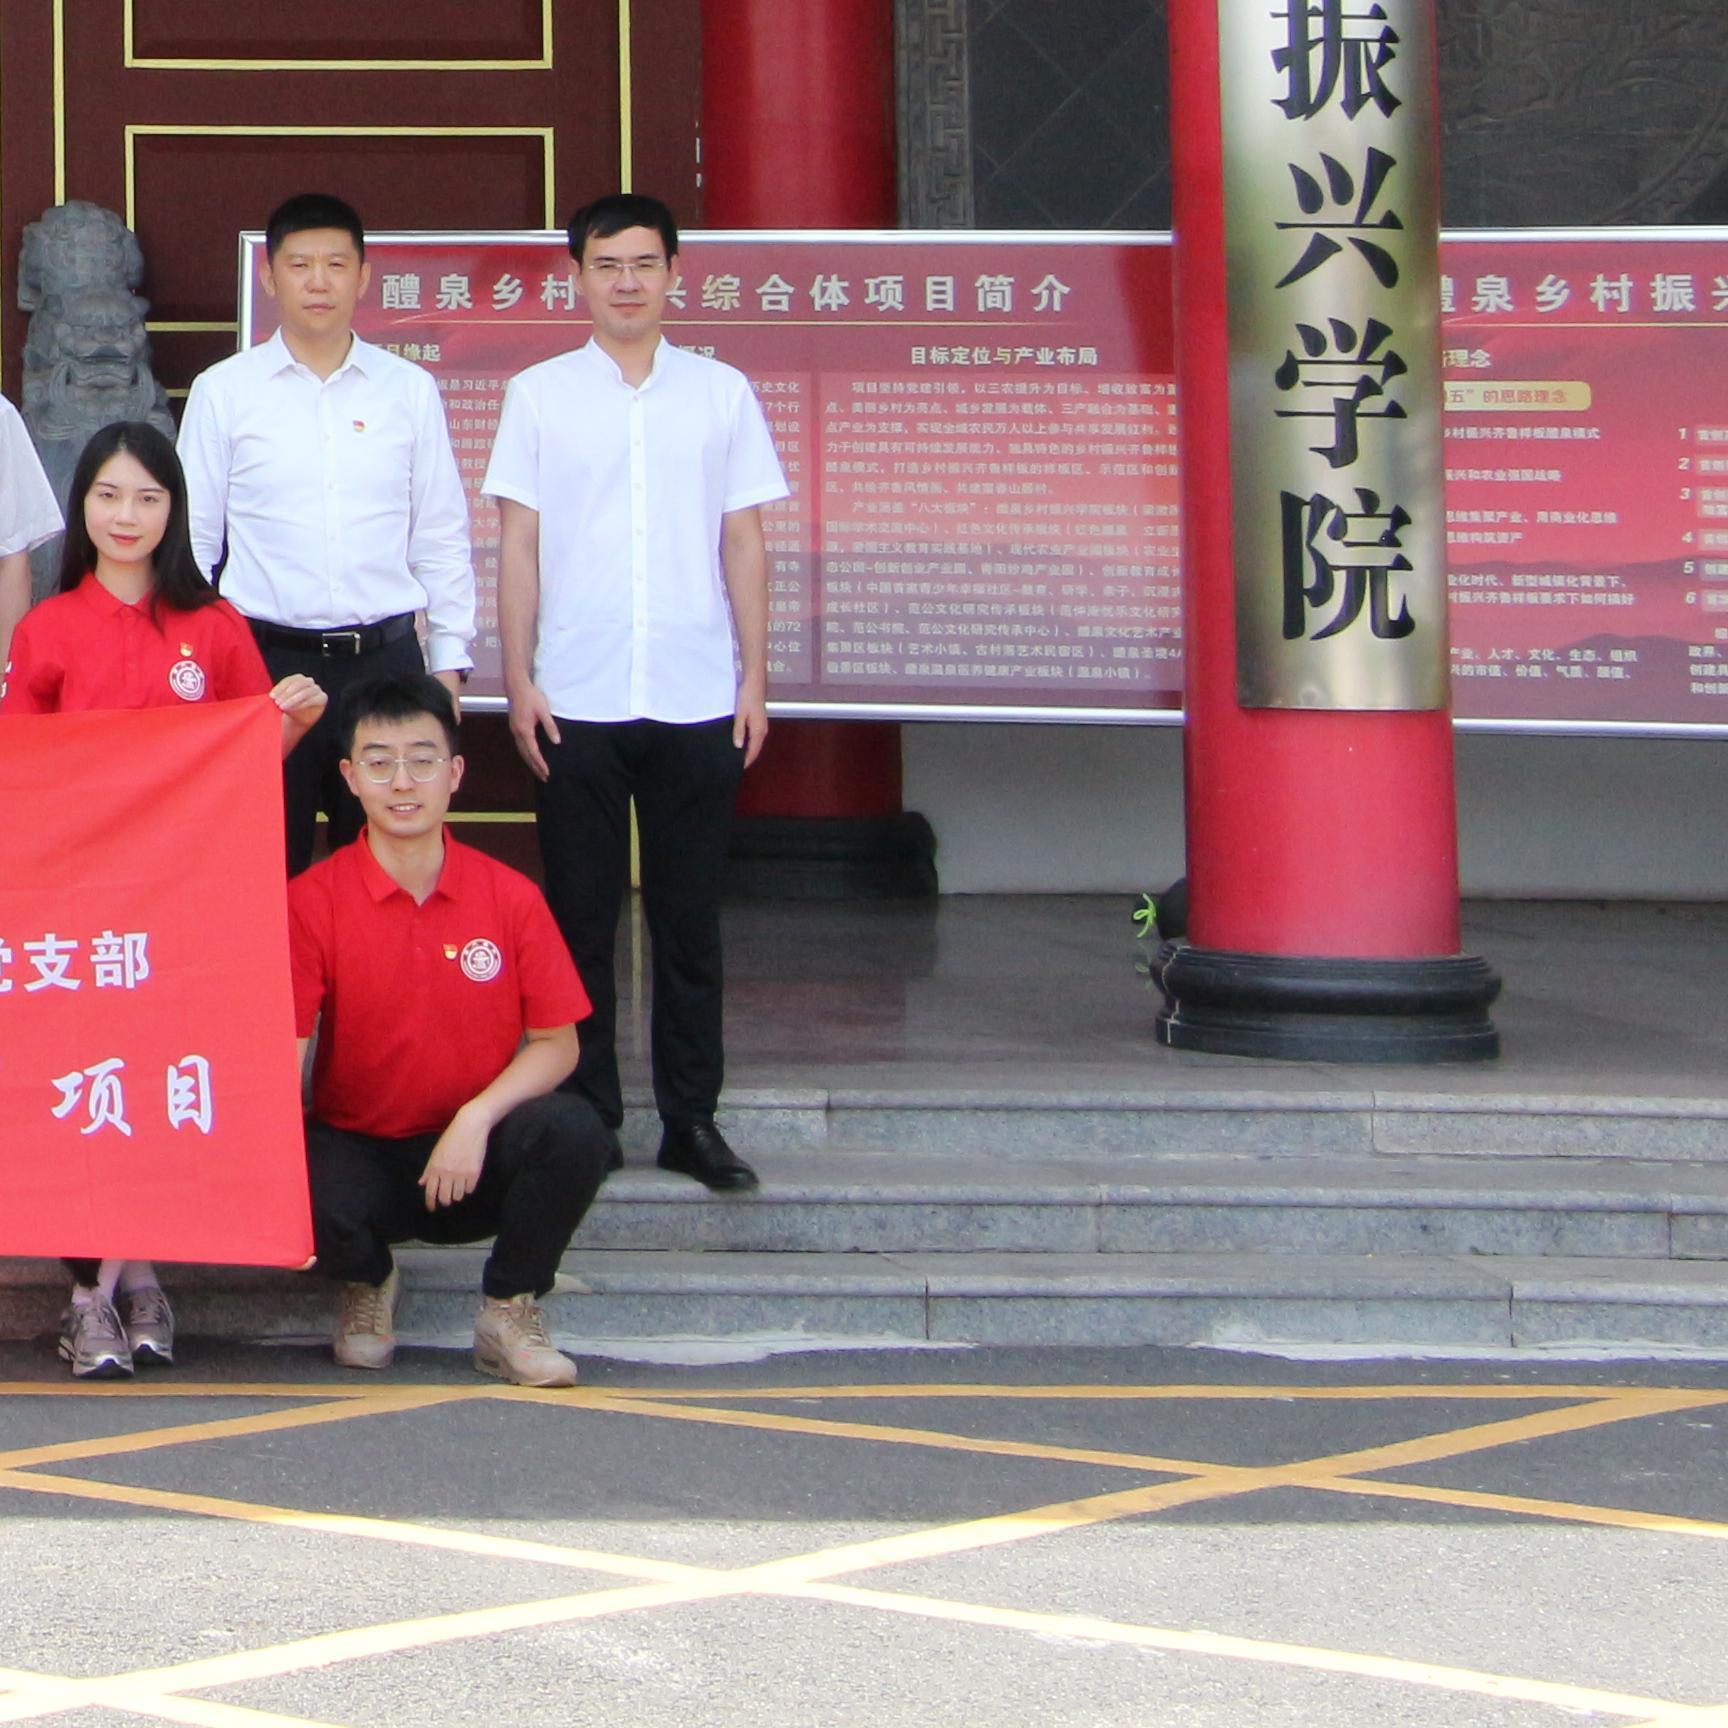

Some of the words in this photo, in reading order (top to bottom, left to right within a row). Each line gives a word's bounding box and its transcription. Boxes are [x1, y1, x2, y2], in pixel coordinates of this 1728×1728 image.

[910, 346, 1098, 366] 目标定位与产业布局
[1678, 427, 1687, 440] 1
[1678, 457, 1690, 471] 2
[1679, 487, 1691, 500] 3
[1682, 531, 1693, 543] 4
[1684, 561, 1695, 574] 5
[1685, 591, 1697, 604] 6
